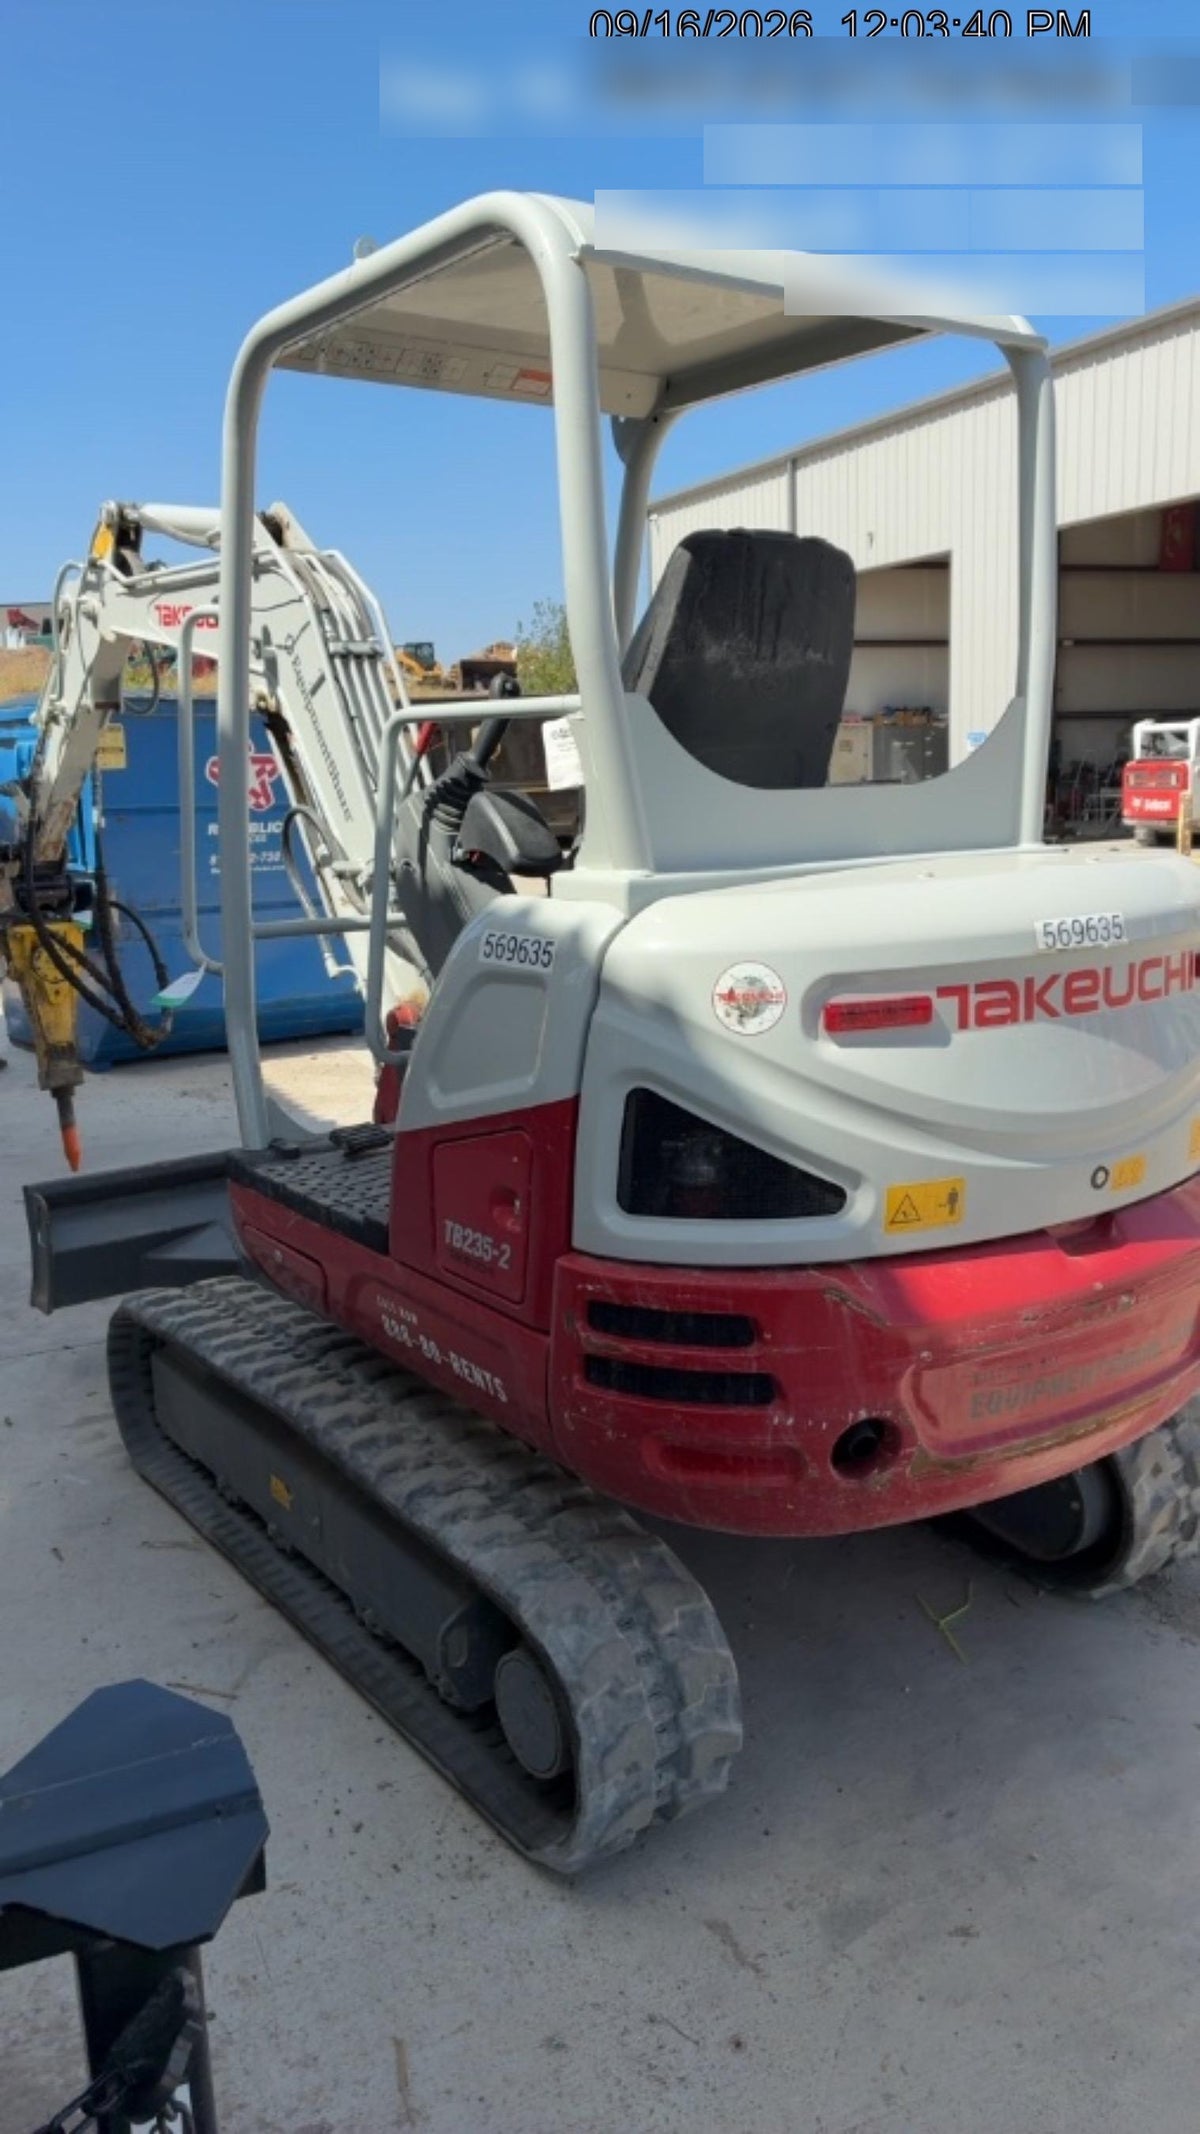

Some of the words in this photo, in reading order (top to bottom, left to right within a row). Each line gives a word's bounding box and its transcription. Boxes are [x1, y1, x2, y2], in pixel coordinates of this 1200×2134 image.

[482, 932, 555, 968] 569635
[1042, 914, 1124, 949] 569635
[936, 950, 1194, 1030] TAKEUCHI
[443, 1218, 512, 1270] TB235-2
